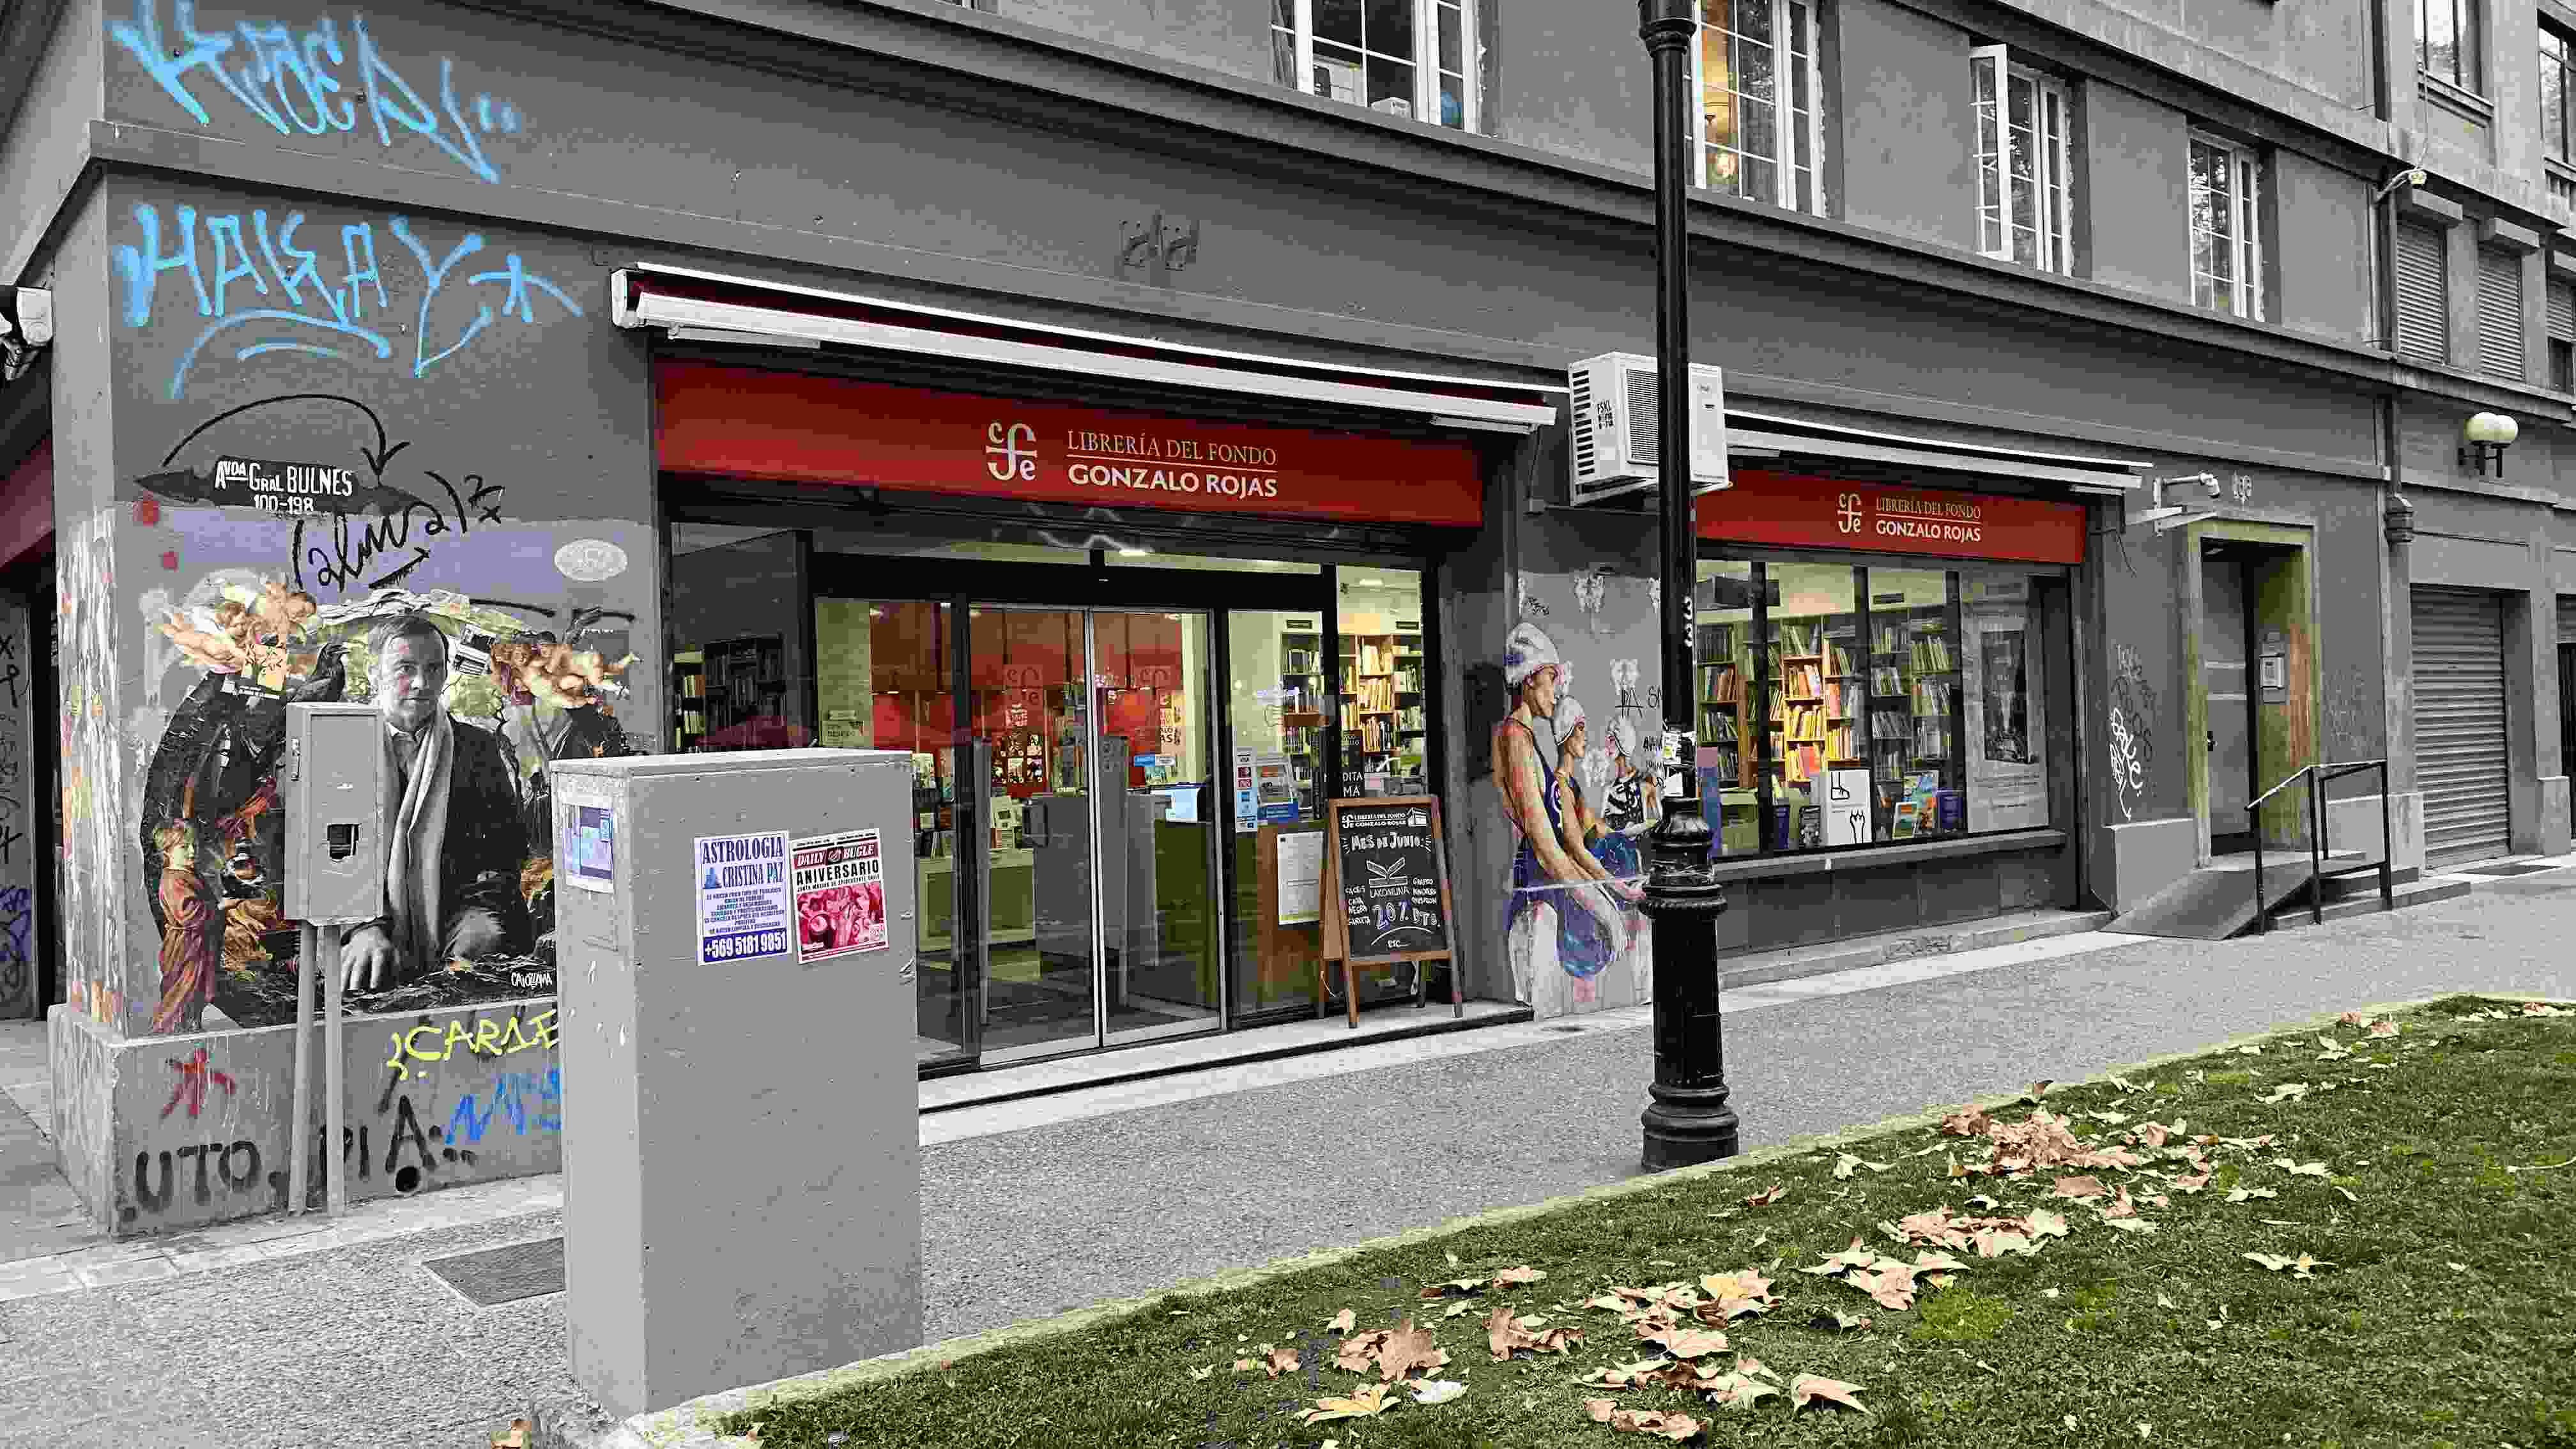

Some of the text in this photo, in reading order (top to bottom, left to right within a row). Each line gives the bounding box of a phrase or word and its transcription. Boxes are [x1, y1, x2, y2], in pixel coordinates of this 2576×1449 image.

[1068, 429, 1278, 466] LIBRERÍA DEL FONDO
[287, 466, 353, 496] BULNES
[1068, 463, 1278, 500] GONZALO ROJAS
[254, 494, 314, 515] 100-198
[1945, 503, 1981, 519] FONDO
[1876, 520, 1981, 544] GONZALO ROJAS
[702, 837, 783, 863] ASTROLOGIA
[797, 844, 874, 865] DAILY BUGLE
[1351, 834, 1374, 851] MES
[722, 864, 764, 887] CRISTINA
[767, 862, 783, 884] PAZ
[797, 859, 878, 886] ANIVERSARIO
[705, 936, 733, 958] +569
